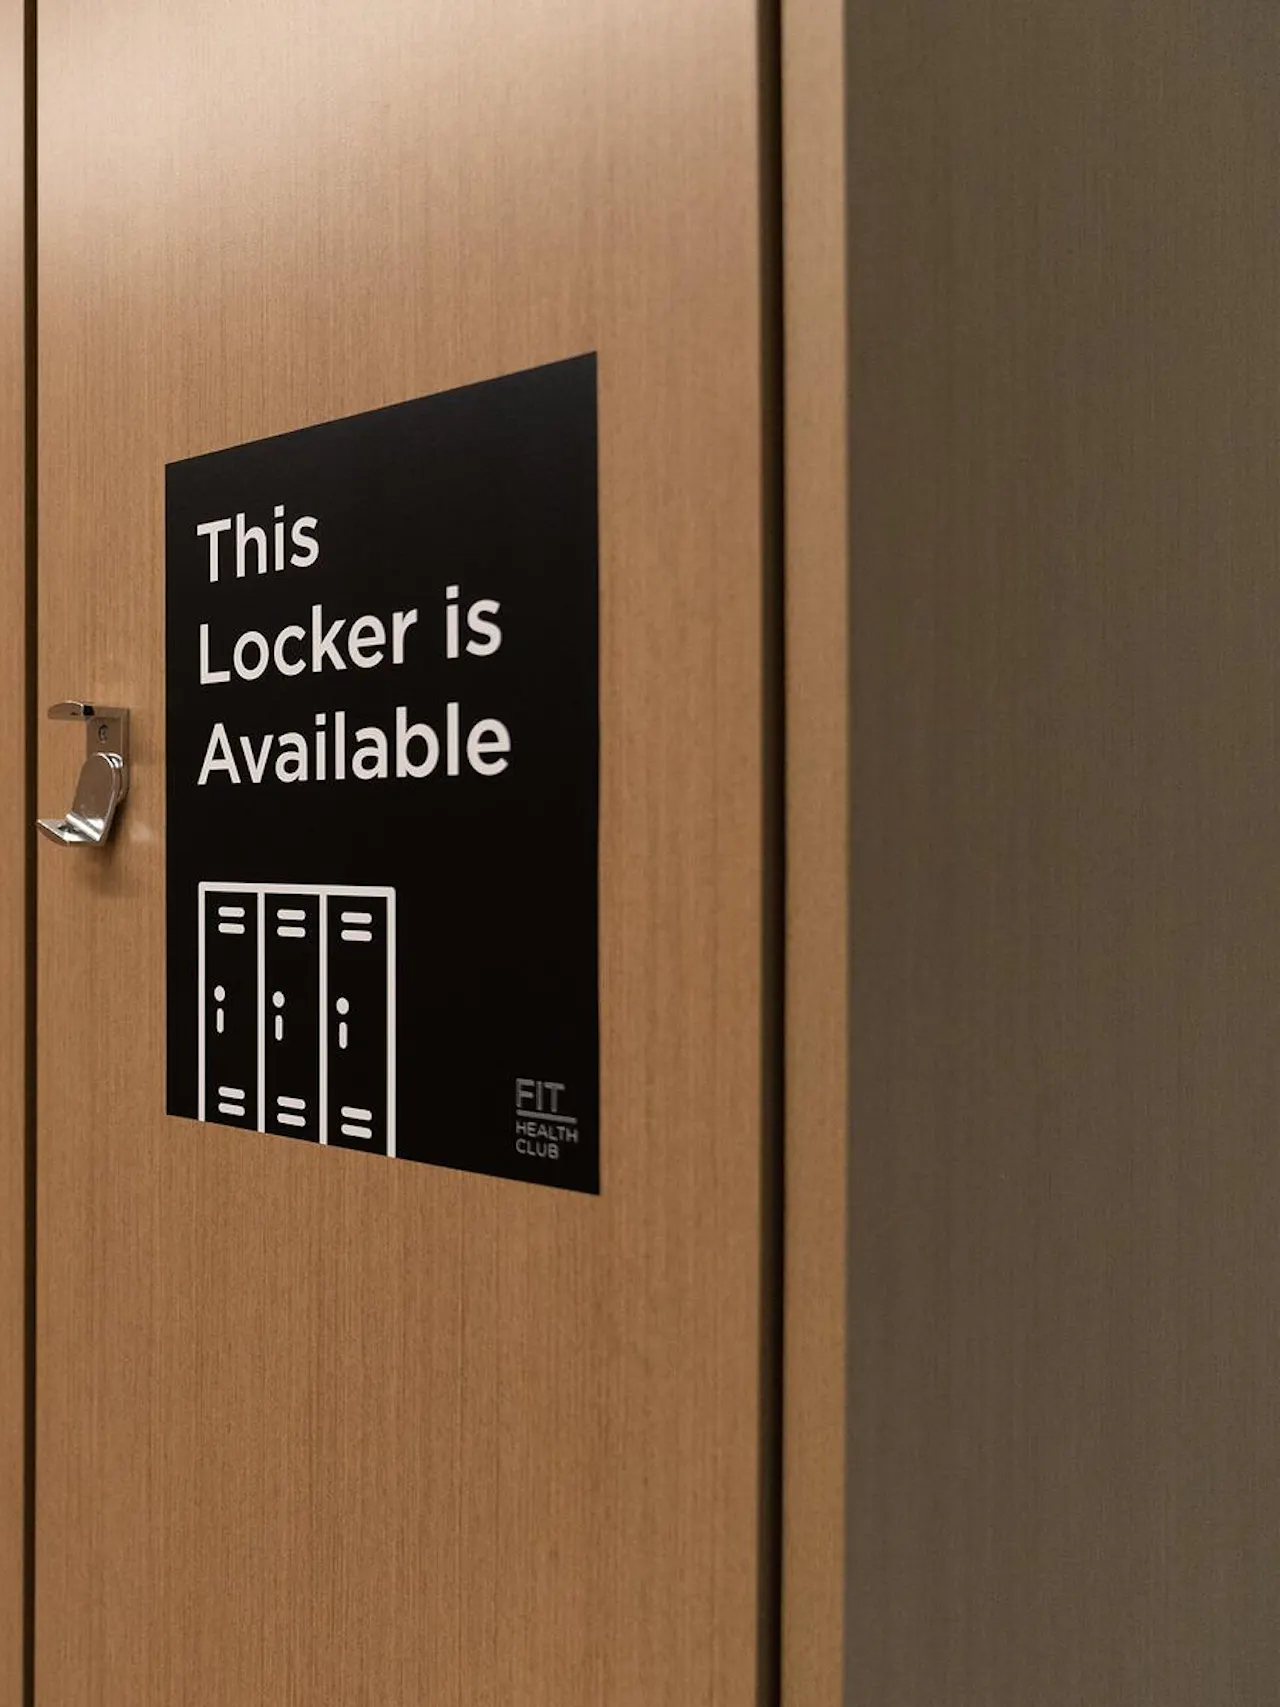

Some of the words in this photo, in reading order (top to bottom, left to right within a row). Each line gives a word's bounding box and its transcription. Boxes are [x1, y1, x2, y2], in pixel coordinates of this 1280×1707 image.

[196, 504, 321, 583] This
[198, 603, 419, 685] Locker
[445, 584, 503, 660] is
[196, 701, 512, 787] Available
[515, 1077, 565, 1113] FIT
[515, 1119, 580, 1144] HEALTH
[515, 1137, 560, 1160] CLUB
